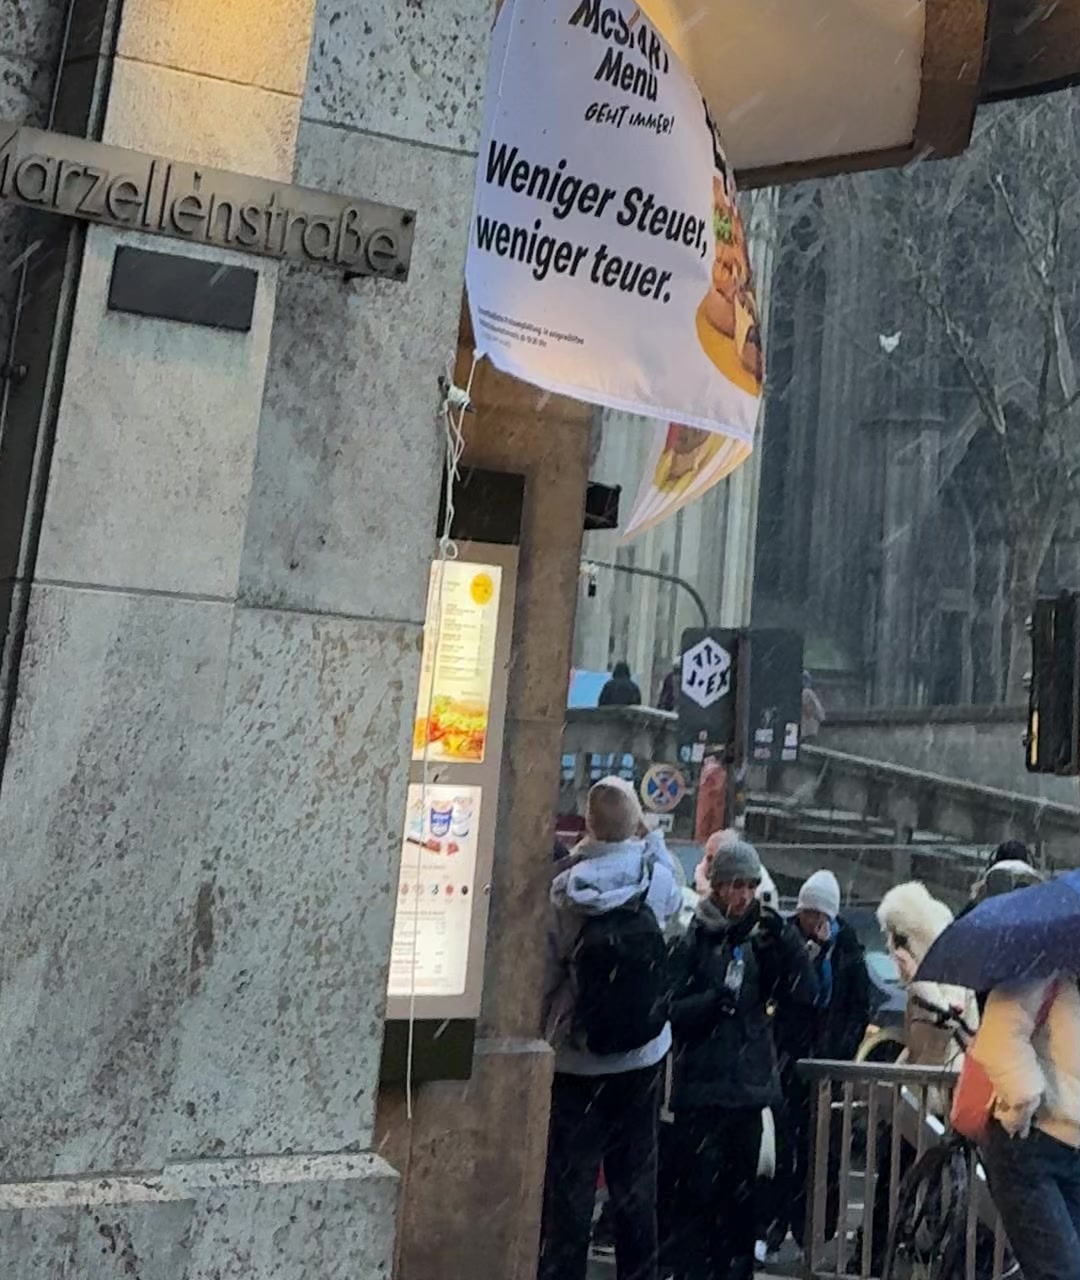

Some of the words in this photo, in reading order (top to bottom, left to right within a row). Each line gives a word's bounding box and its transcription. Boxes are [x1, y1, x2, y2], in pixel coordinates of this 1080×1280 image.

[585, 102, 630, 128] GEHT
[629, 112, 675, 134] IMMER!
[486, 140, 616, 220] Weniger
[616, 187, 707, 257] Steuer,
[477, 215, 588, 281] weniger
[591, 244, 672, 303] teuer.
